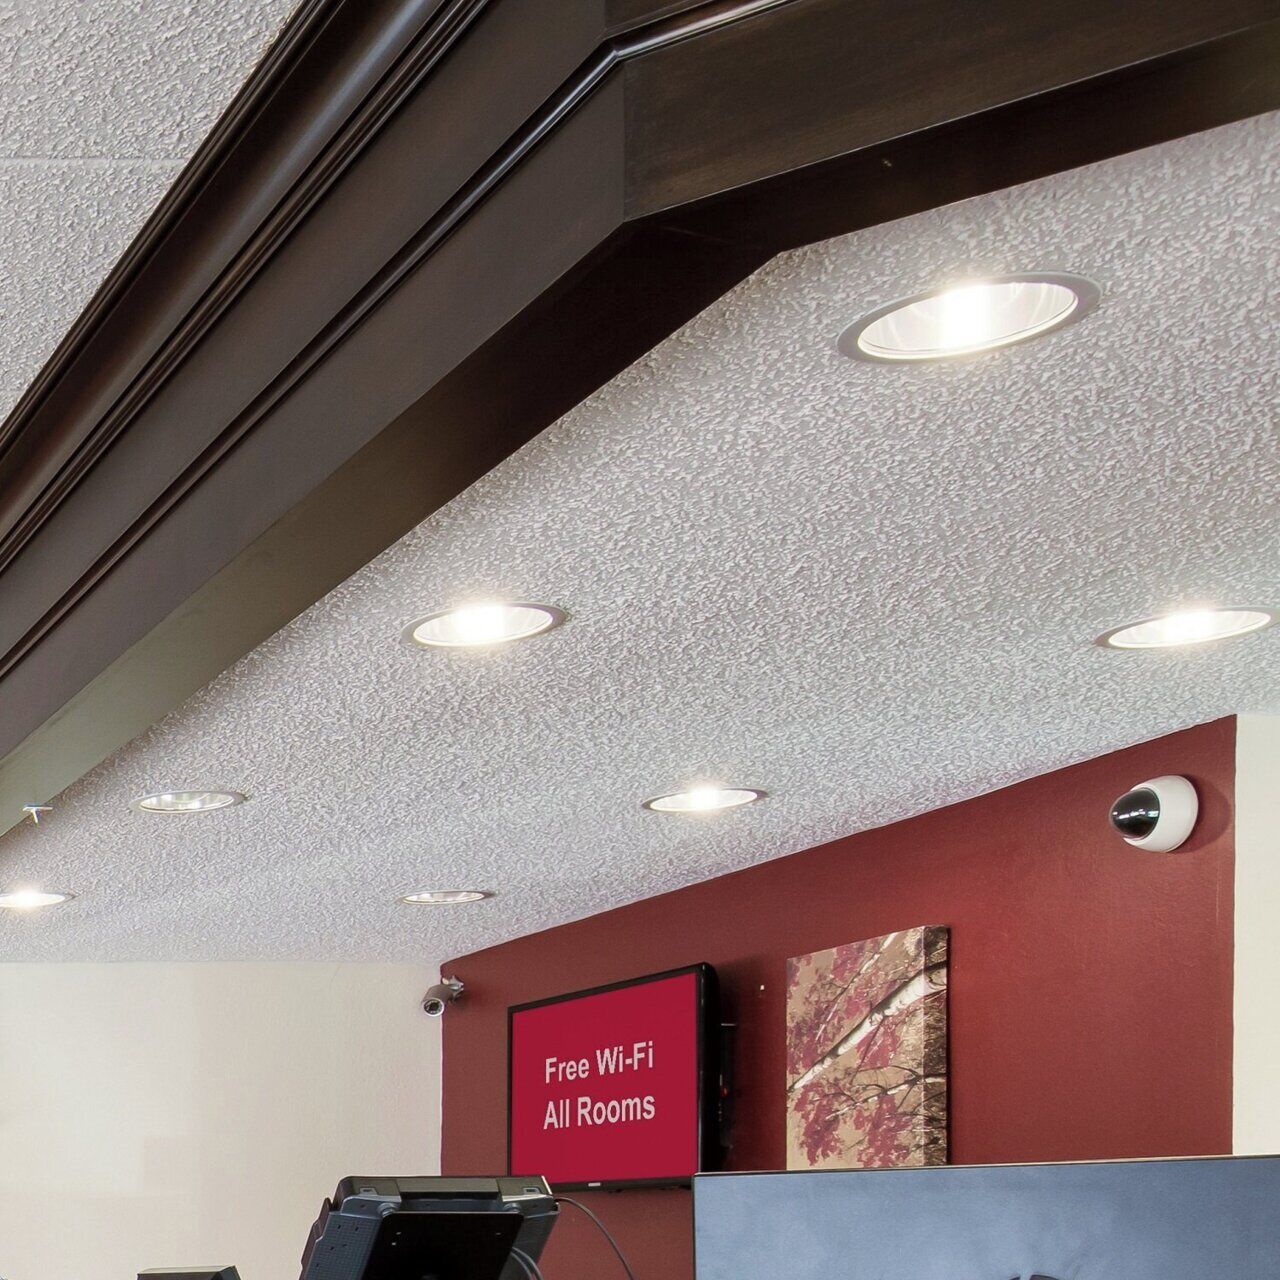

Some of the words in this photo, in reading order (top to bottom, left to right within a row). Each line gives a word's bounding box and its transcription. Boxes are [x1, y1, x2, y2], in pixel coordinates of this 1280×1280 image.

[545, 1057, 590, 1084] Free
[595, 1040, 653, 1076] Wi-Fi
[543, 1099, 570, 1130] All
[577, 1095, 656, 1127] Rooms
